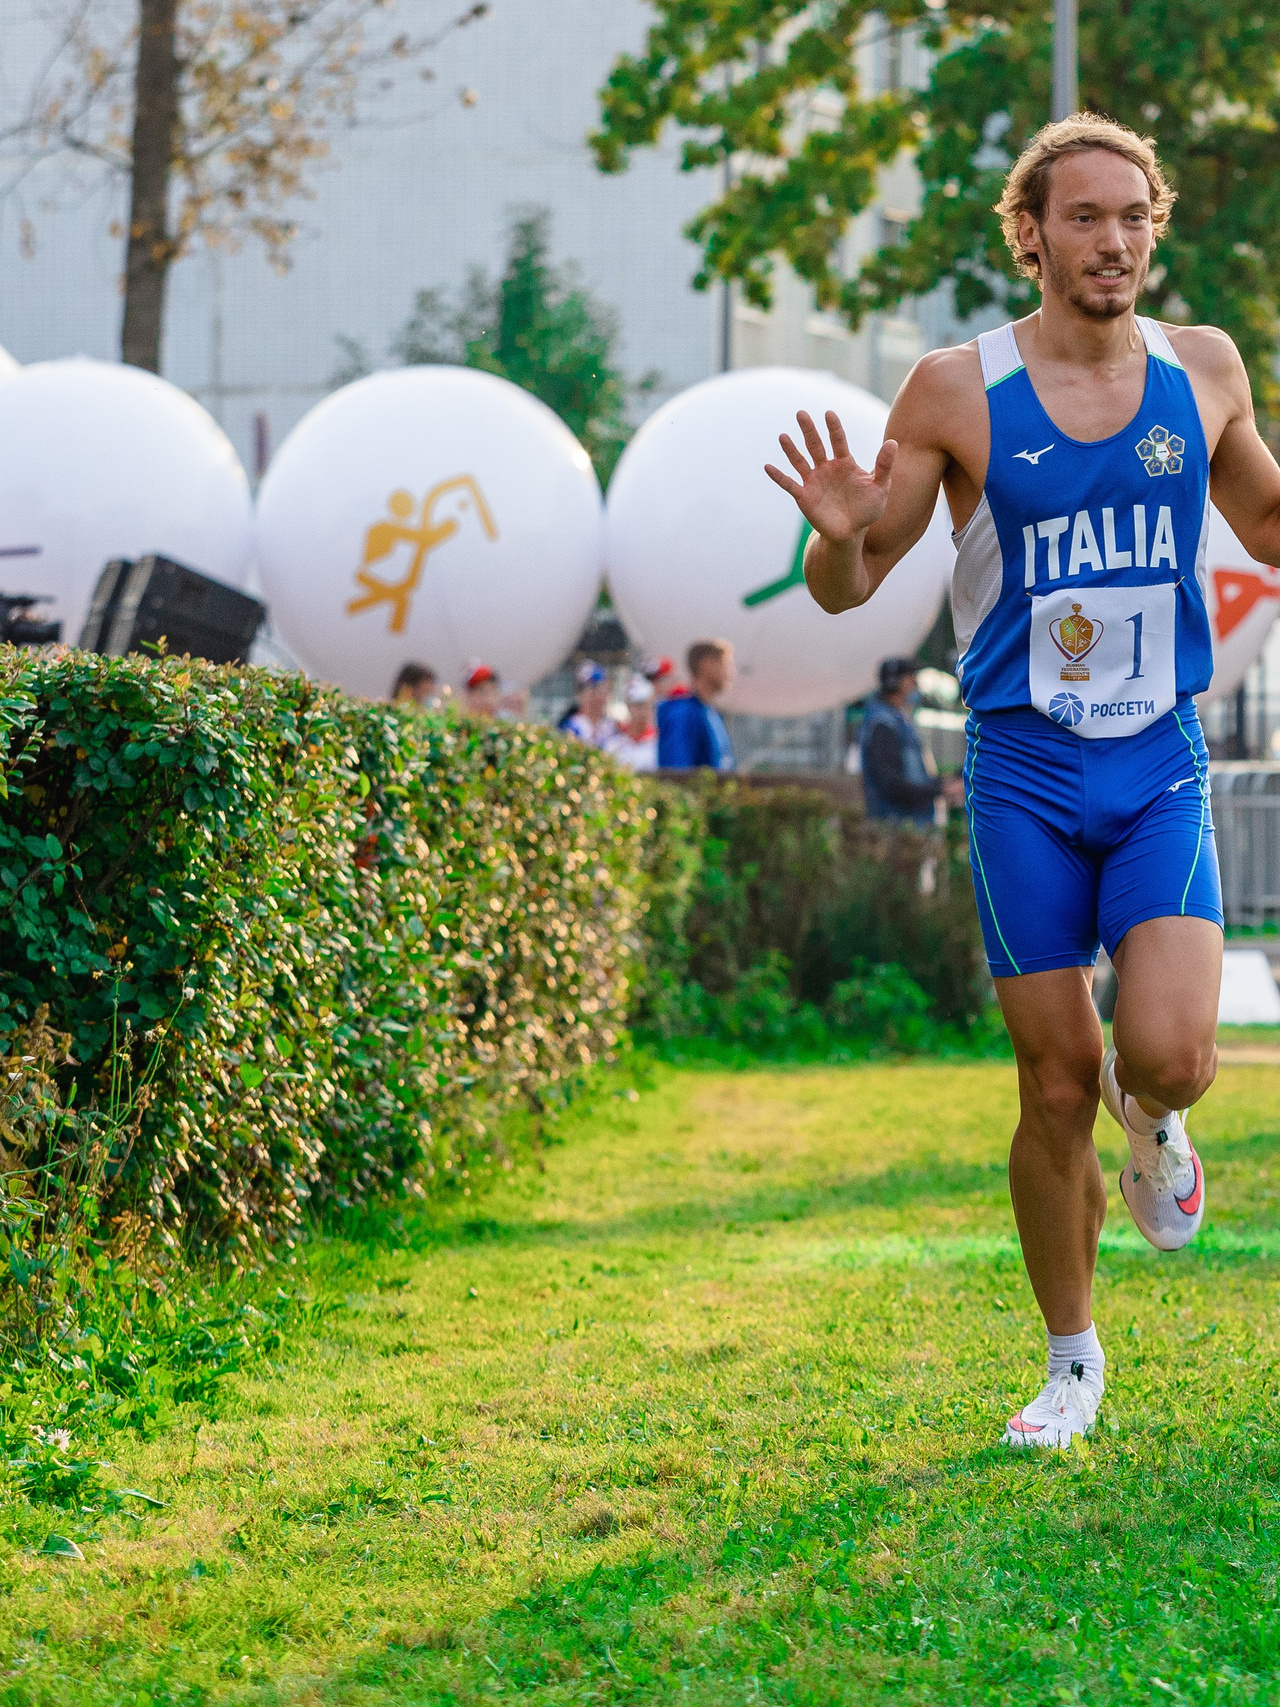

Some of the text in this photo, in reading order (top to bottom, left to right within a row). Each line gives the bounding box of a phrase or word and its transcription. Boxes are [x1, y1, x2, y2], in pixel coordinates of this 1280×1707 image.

[1022, 504, 1178, 588] ITALIA
[1124, 611, 1145, 680] 1
[1090, 700, 1155, 718] РОССЕТИ
